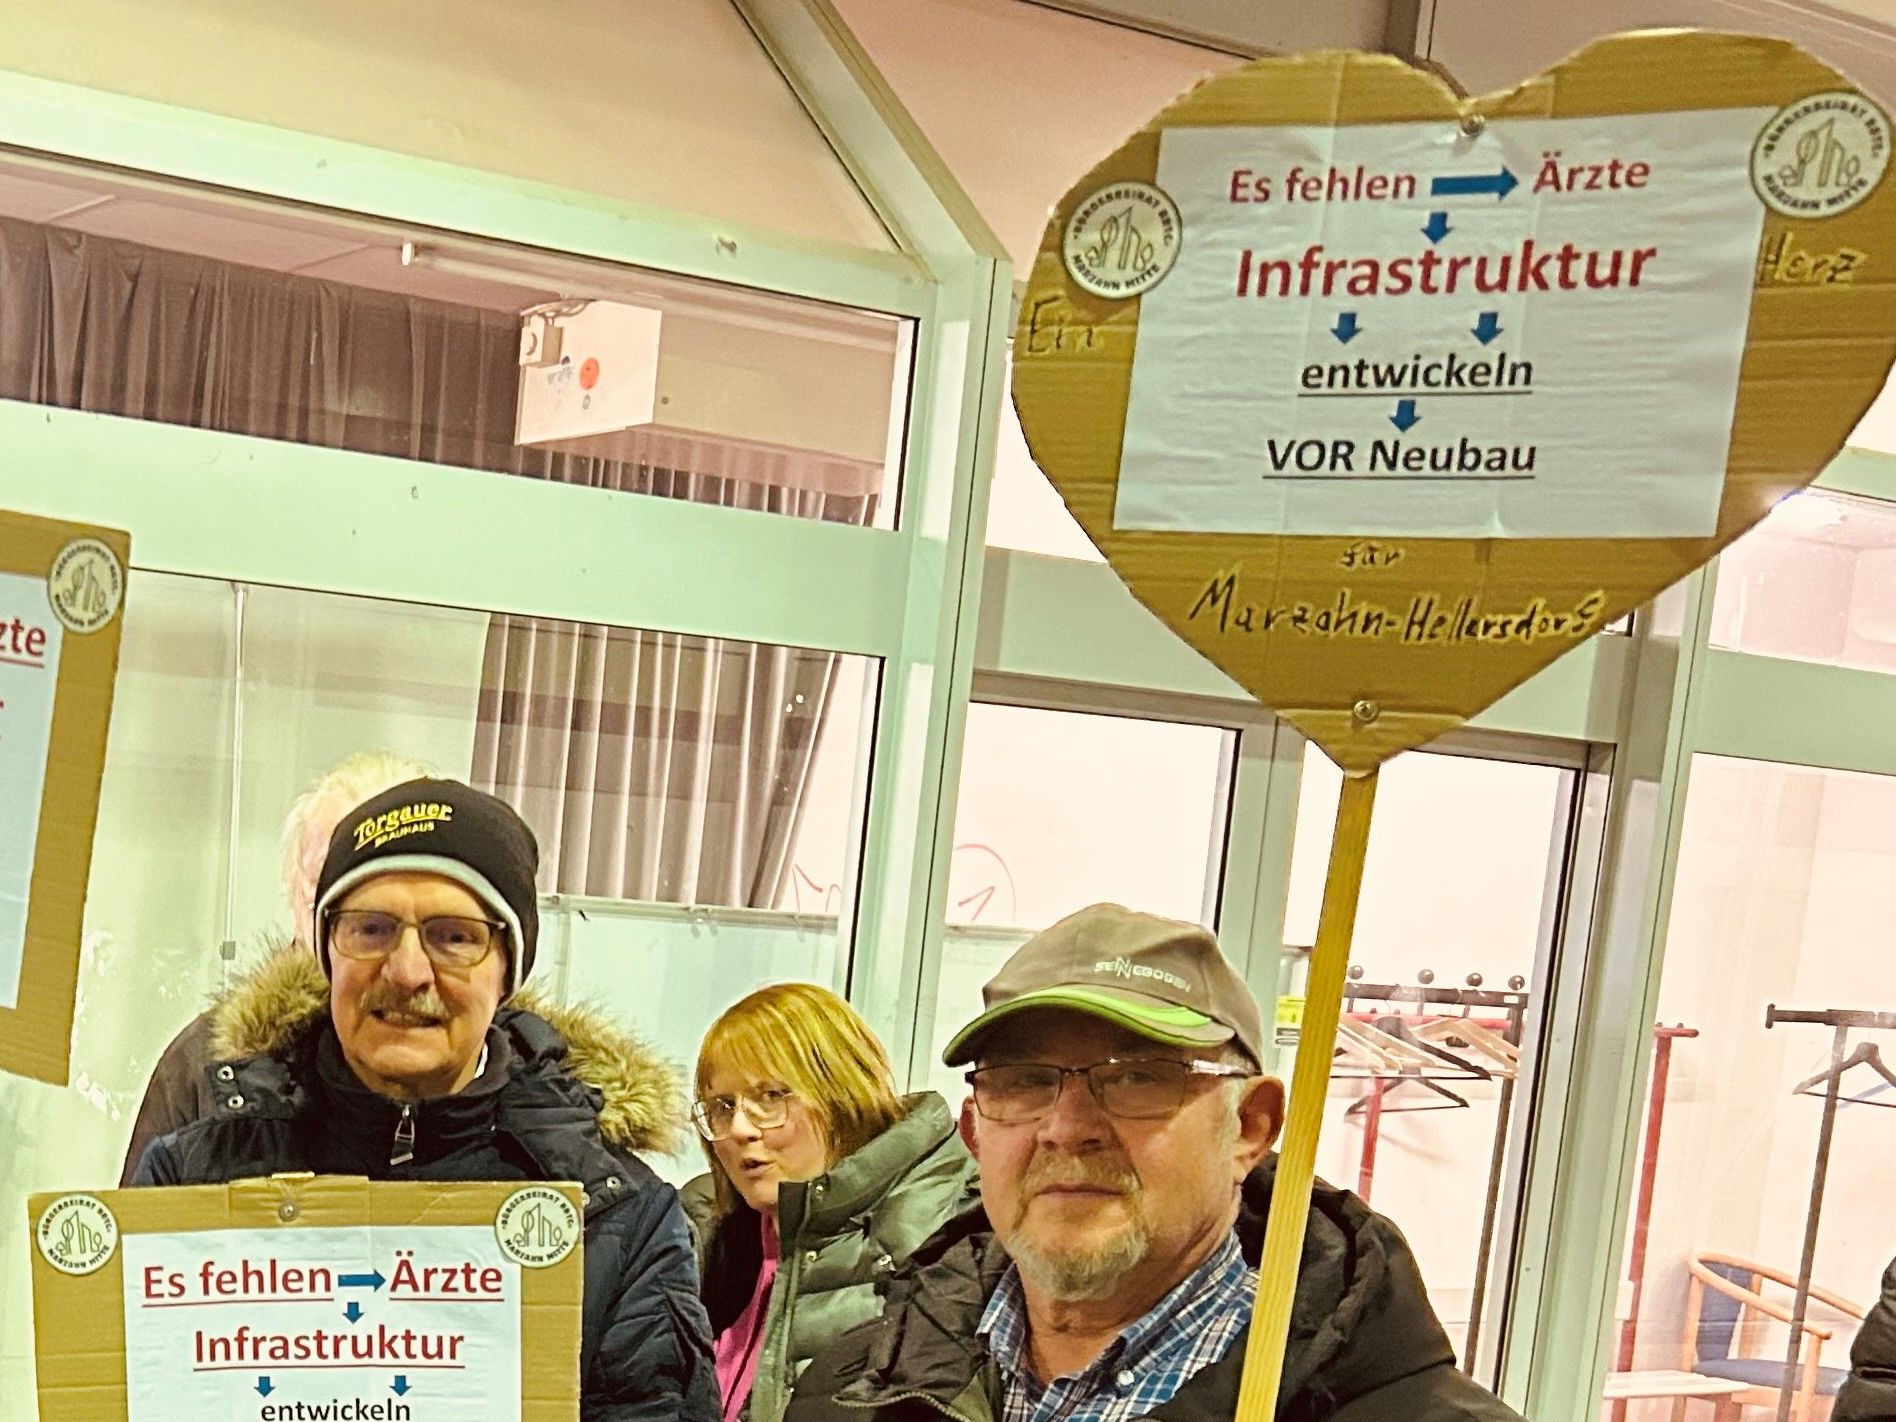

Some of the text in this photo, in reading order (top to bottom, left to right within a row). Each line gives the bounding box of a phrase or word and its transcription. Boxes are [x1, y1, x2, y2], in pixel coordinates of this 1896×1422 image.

[1230, 151, 1650, 203] Es fehlen Ärzte
[1237, 240, 1657, 298] Infrastruktur
[1761, 232, 1856, 283] Herz
[1301, 355, 1532, 389] entwickeln
[1267, 436, 1537, 473] VOR Neubau
[353, 803, 453, 850] Torgauer
[143, 1250, 503, 1299] Es fehlen Ärzte
[194, 1325, 464, 1363] Infrastruktur
[261, 1398, 411, 1422] entwickeln
